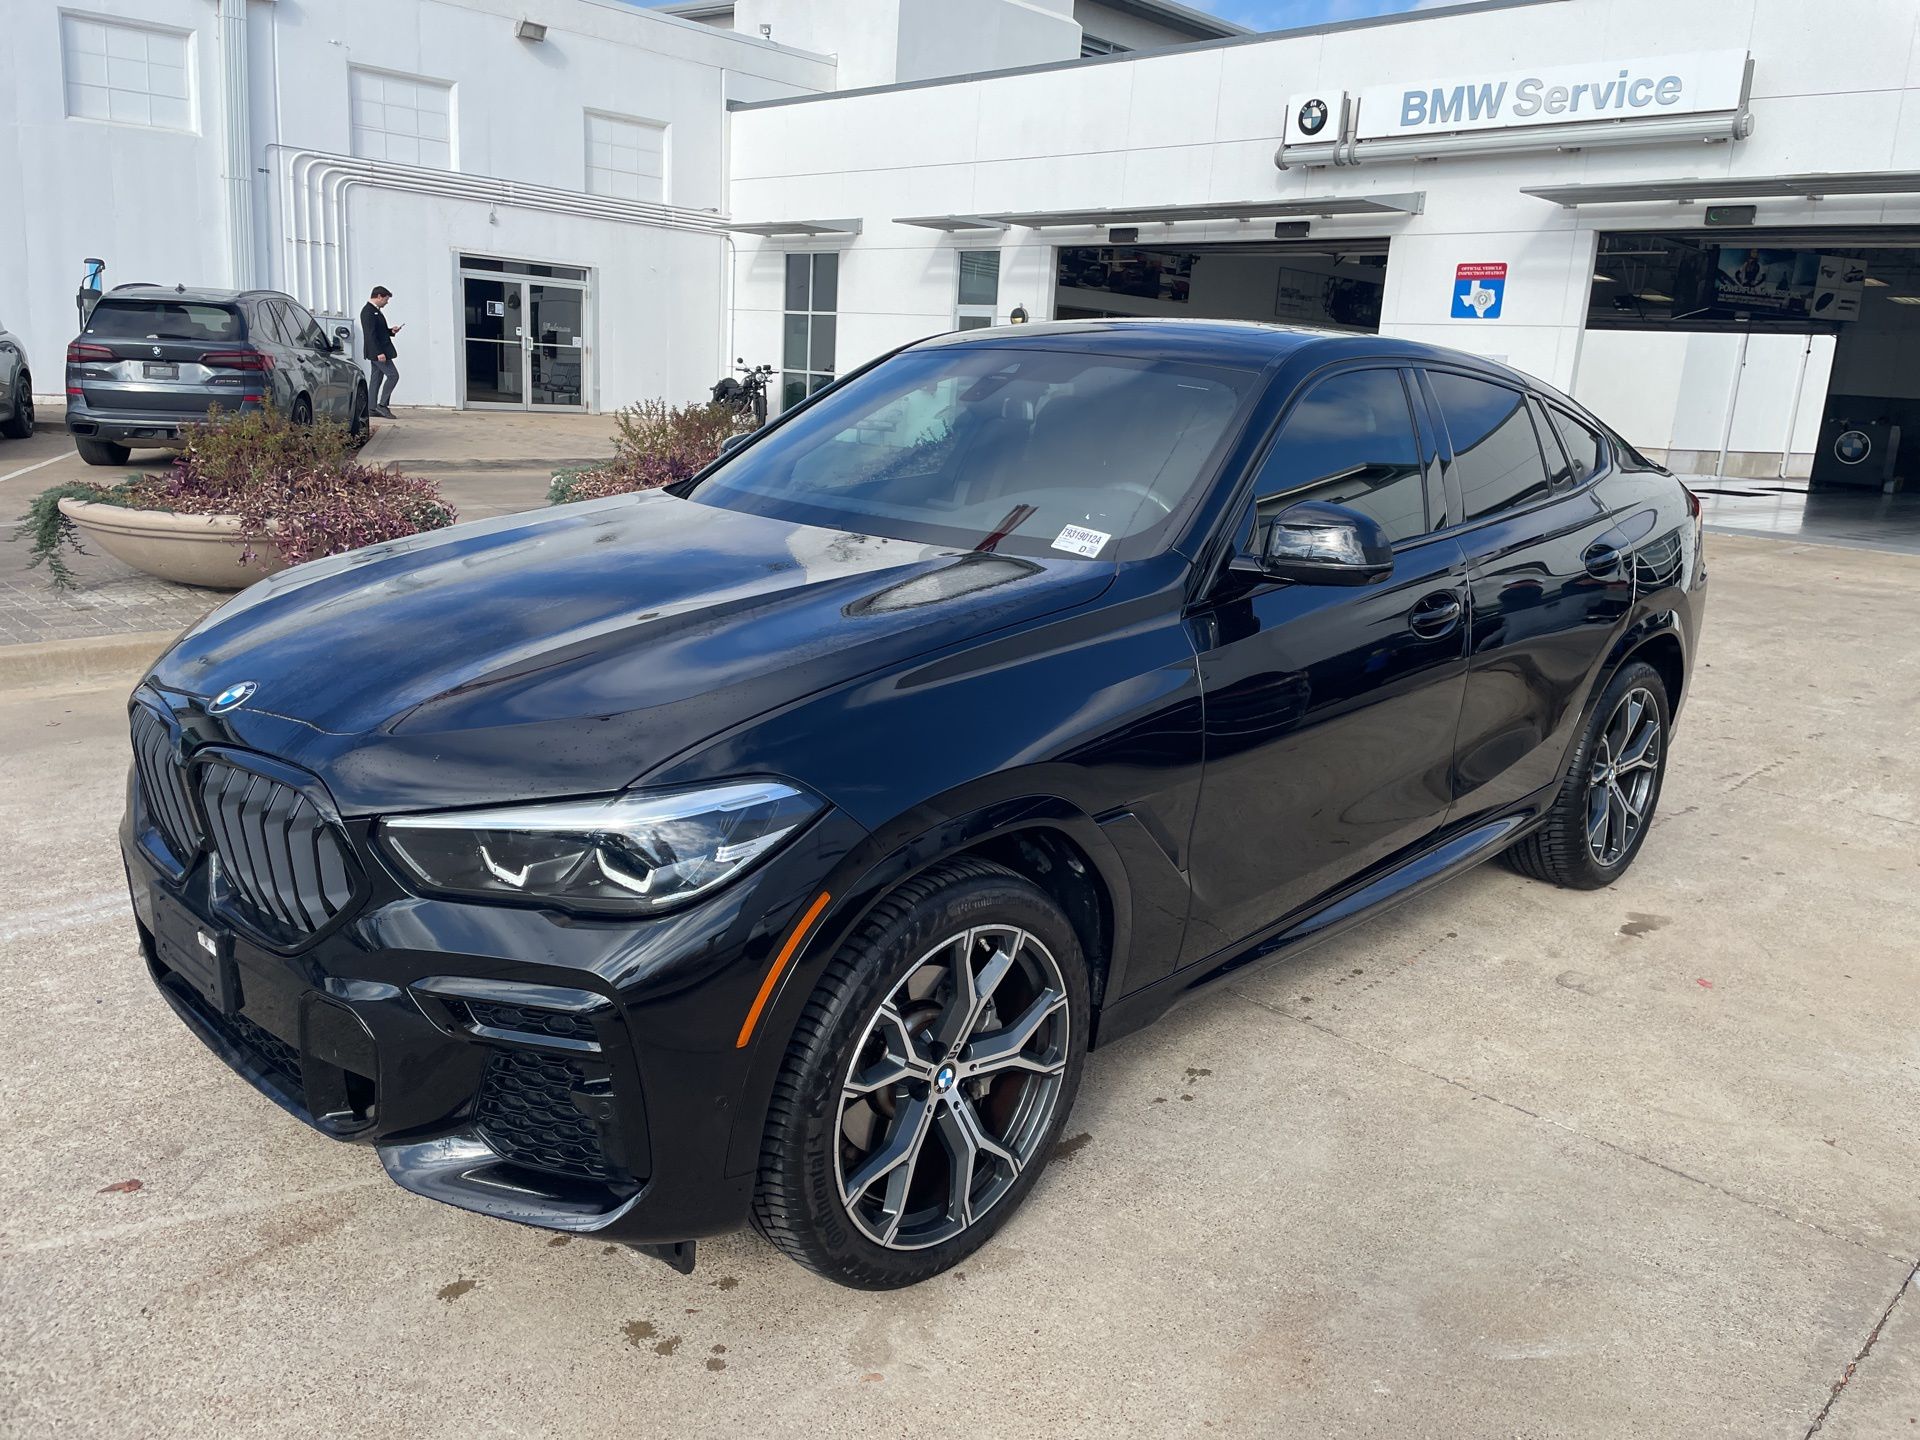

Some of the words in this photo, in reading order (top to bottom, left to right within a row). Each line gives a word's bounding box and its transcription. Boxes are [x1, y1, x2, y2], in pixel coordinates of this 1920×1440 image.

[1400, 82, 1508, 127] BMW
[1512, 70, 1683, 117] Service
[1061, 527, 1102, 545] T9319012A
